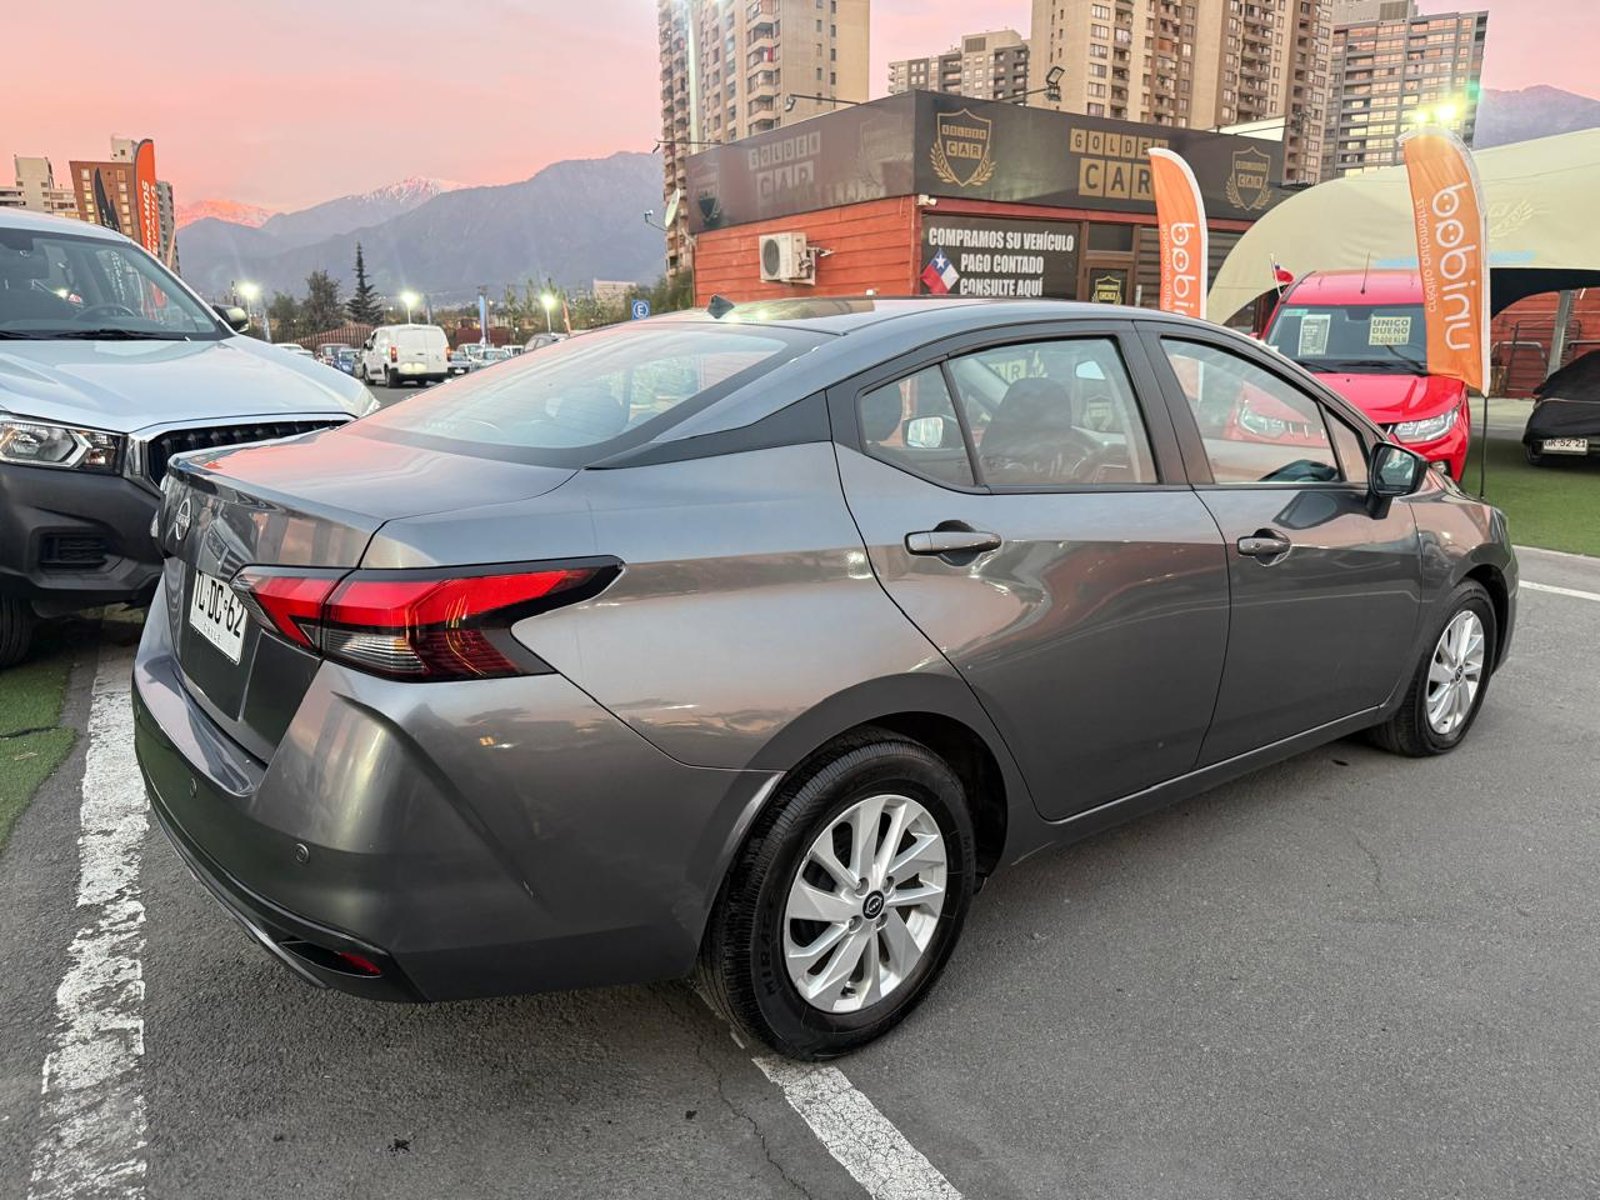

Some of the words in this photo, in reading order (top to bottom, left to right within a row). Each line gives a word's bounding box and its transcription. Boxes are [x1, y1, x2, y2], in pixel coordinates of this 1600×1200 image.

[948, 142, 980, 157] CAR
[1075, 133, 1165, 155] GOLDE
[1084, 163, 1151, 194] CAR
[928, 227, 1004, 249] COMPRAMOS
[1006, 231, 1021, 250] SU
[1023, 231, 1075, 252] VEHÍCULO
[960, 253, 992, 273] PAGO
[993, 254, 1044, 274] CONTADO
[959, 278, 1017, 296] CONSULTE
[1017, 277, 1043, 297] AQUÍ
[637, 304, 645, 316] E
